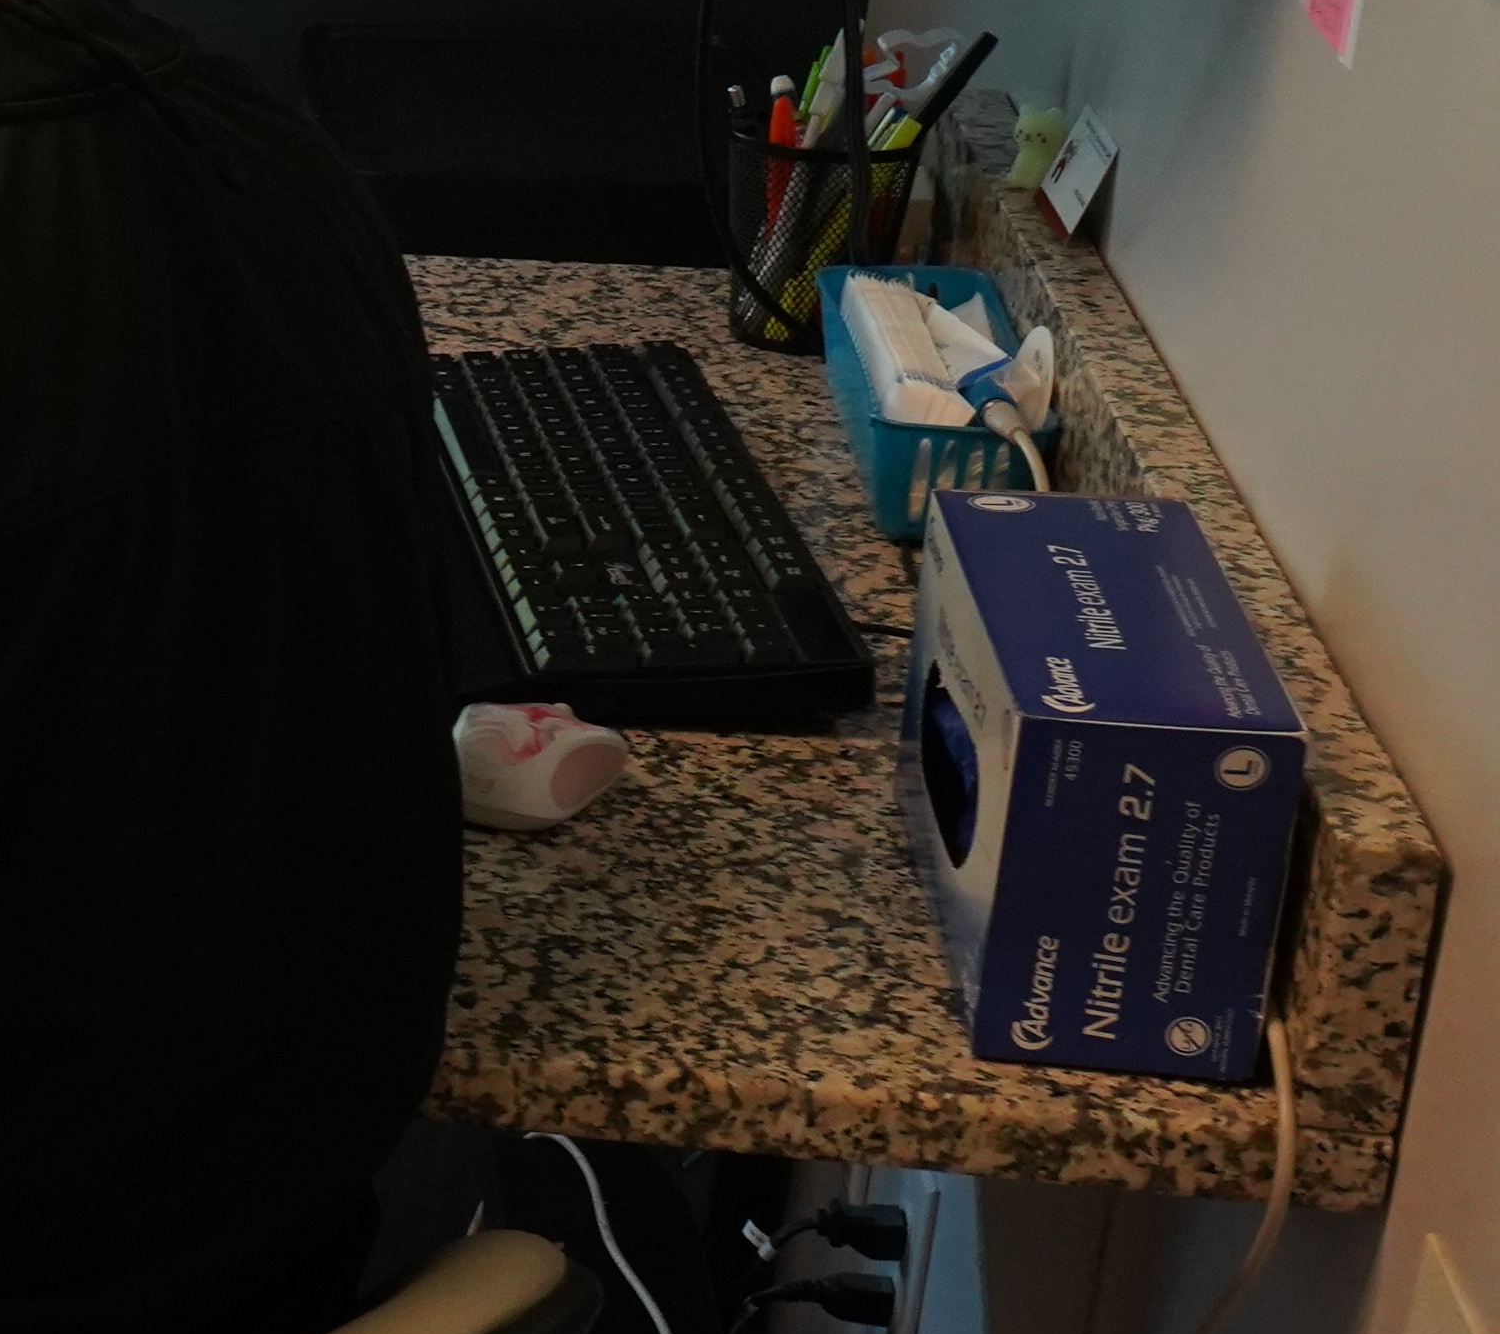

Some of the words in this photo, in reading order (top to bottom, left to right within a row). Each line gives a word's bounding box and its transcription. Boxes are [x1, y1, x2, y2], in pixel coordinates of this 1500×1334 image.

[1047, 543, 1088, 568] 2.7
[1062, 569, 1108, 606] exam
[1076, 608, 1127, 651] Nitrile
[1040, 655, 1096, 714] Advance
[1118, 763, 1157, 821] 2.7
[1221, 759, 1253, 778] L
[1185, 799, 1202, 819] of
[1108, 833, 1147, 924] exam
[1171, 823, 1202, 884] Quality
[1191, 813, 1222, 887] Products
[1167, 890, 1185, 917] the
[1183, 893, 1206, 932] Care
[1080, 932, 1132, 1040] Nitrile
[1153, 923, 1185, 1003] Advancing
[1175, 938, 1200, 994] Dental
[1009, 934, 1060, 1051] Advance
